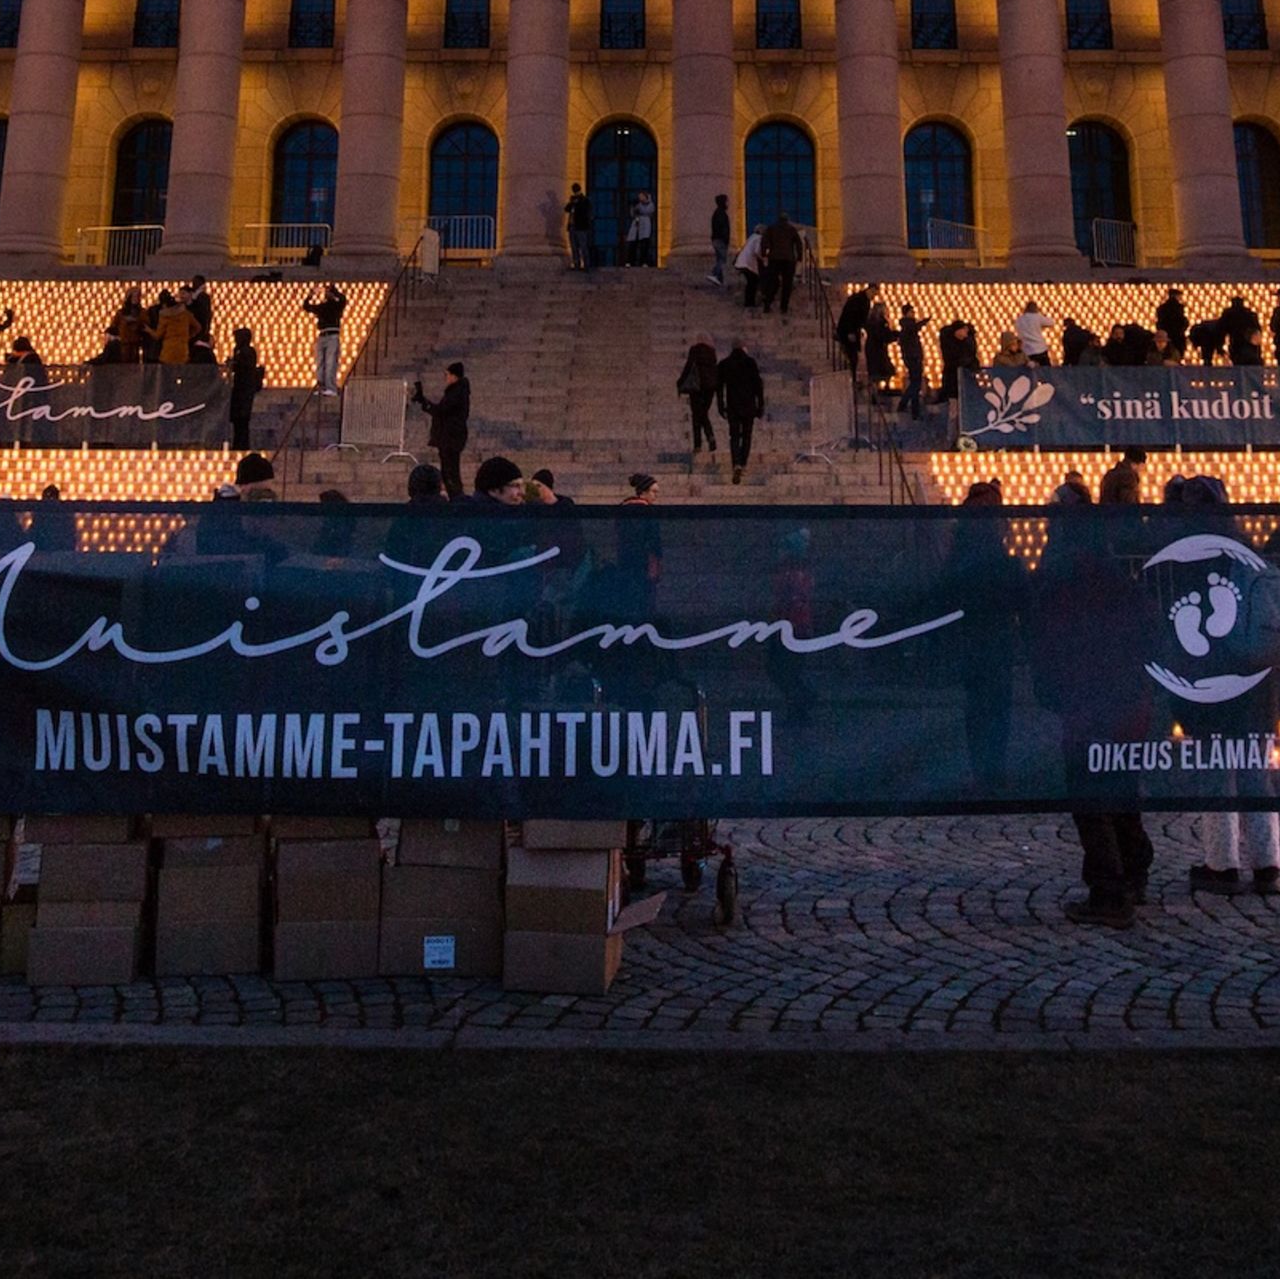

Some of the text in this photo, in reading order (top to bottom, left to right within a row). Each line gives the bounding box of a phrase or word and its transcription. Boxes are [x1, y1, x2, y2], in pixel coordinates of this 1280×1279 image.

[1171, 391, 1275, 420] kudoit
[34, 708, 774, 779] MUISTAMME-TAPAHTUMA.FI
[1088, 741, 1173, 773] OIKEUS
